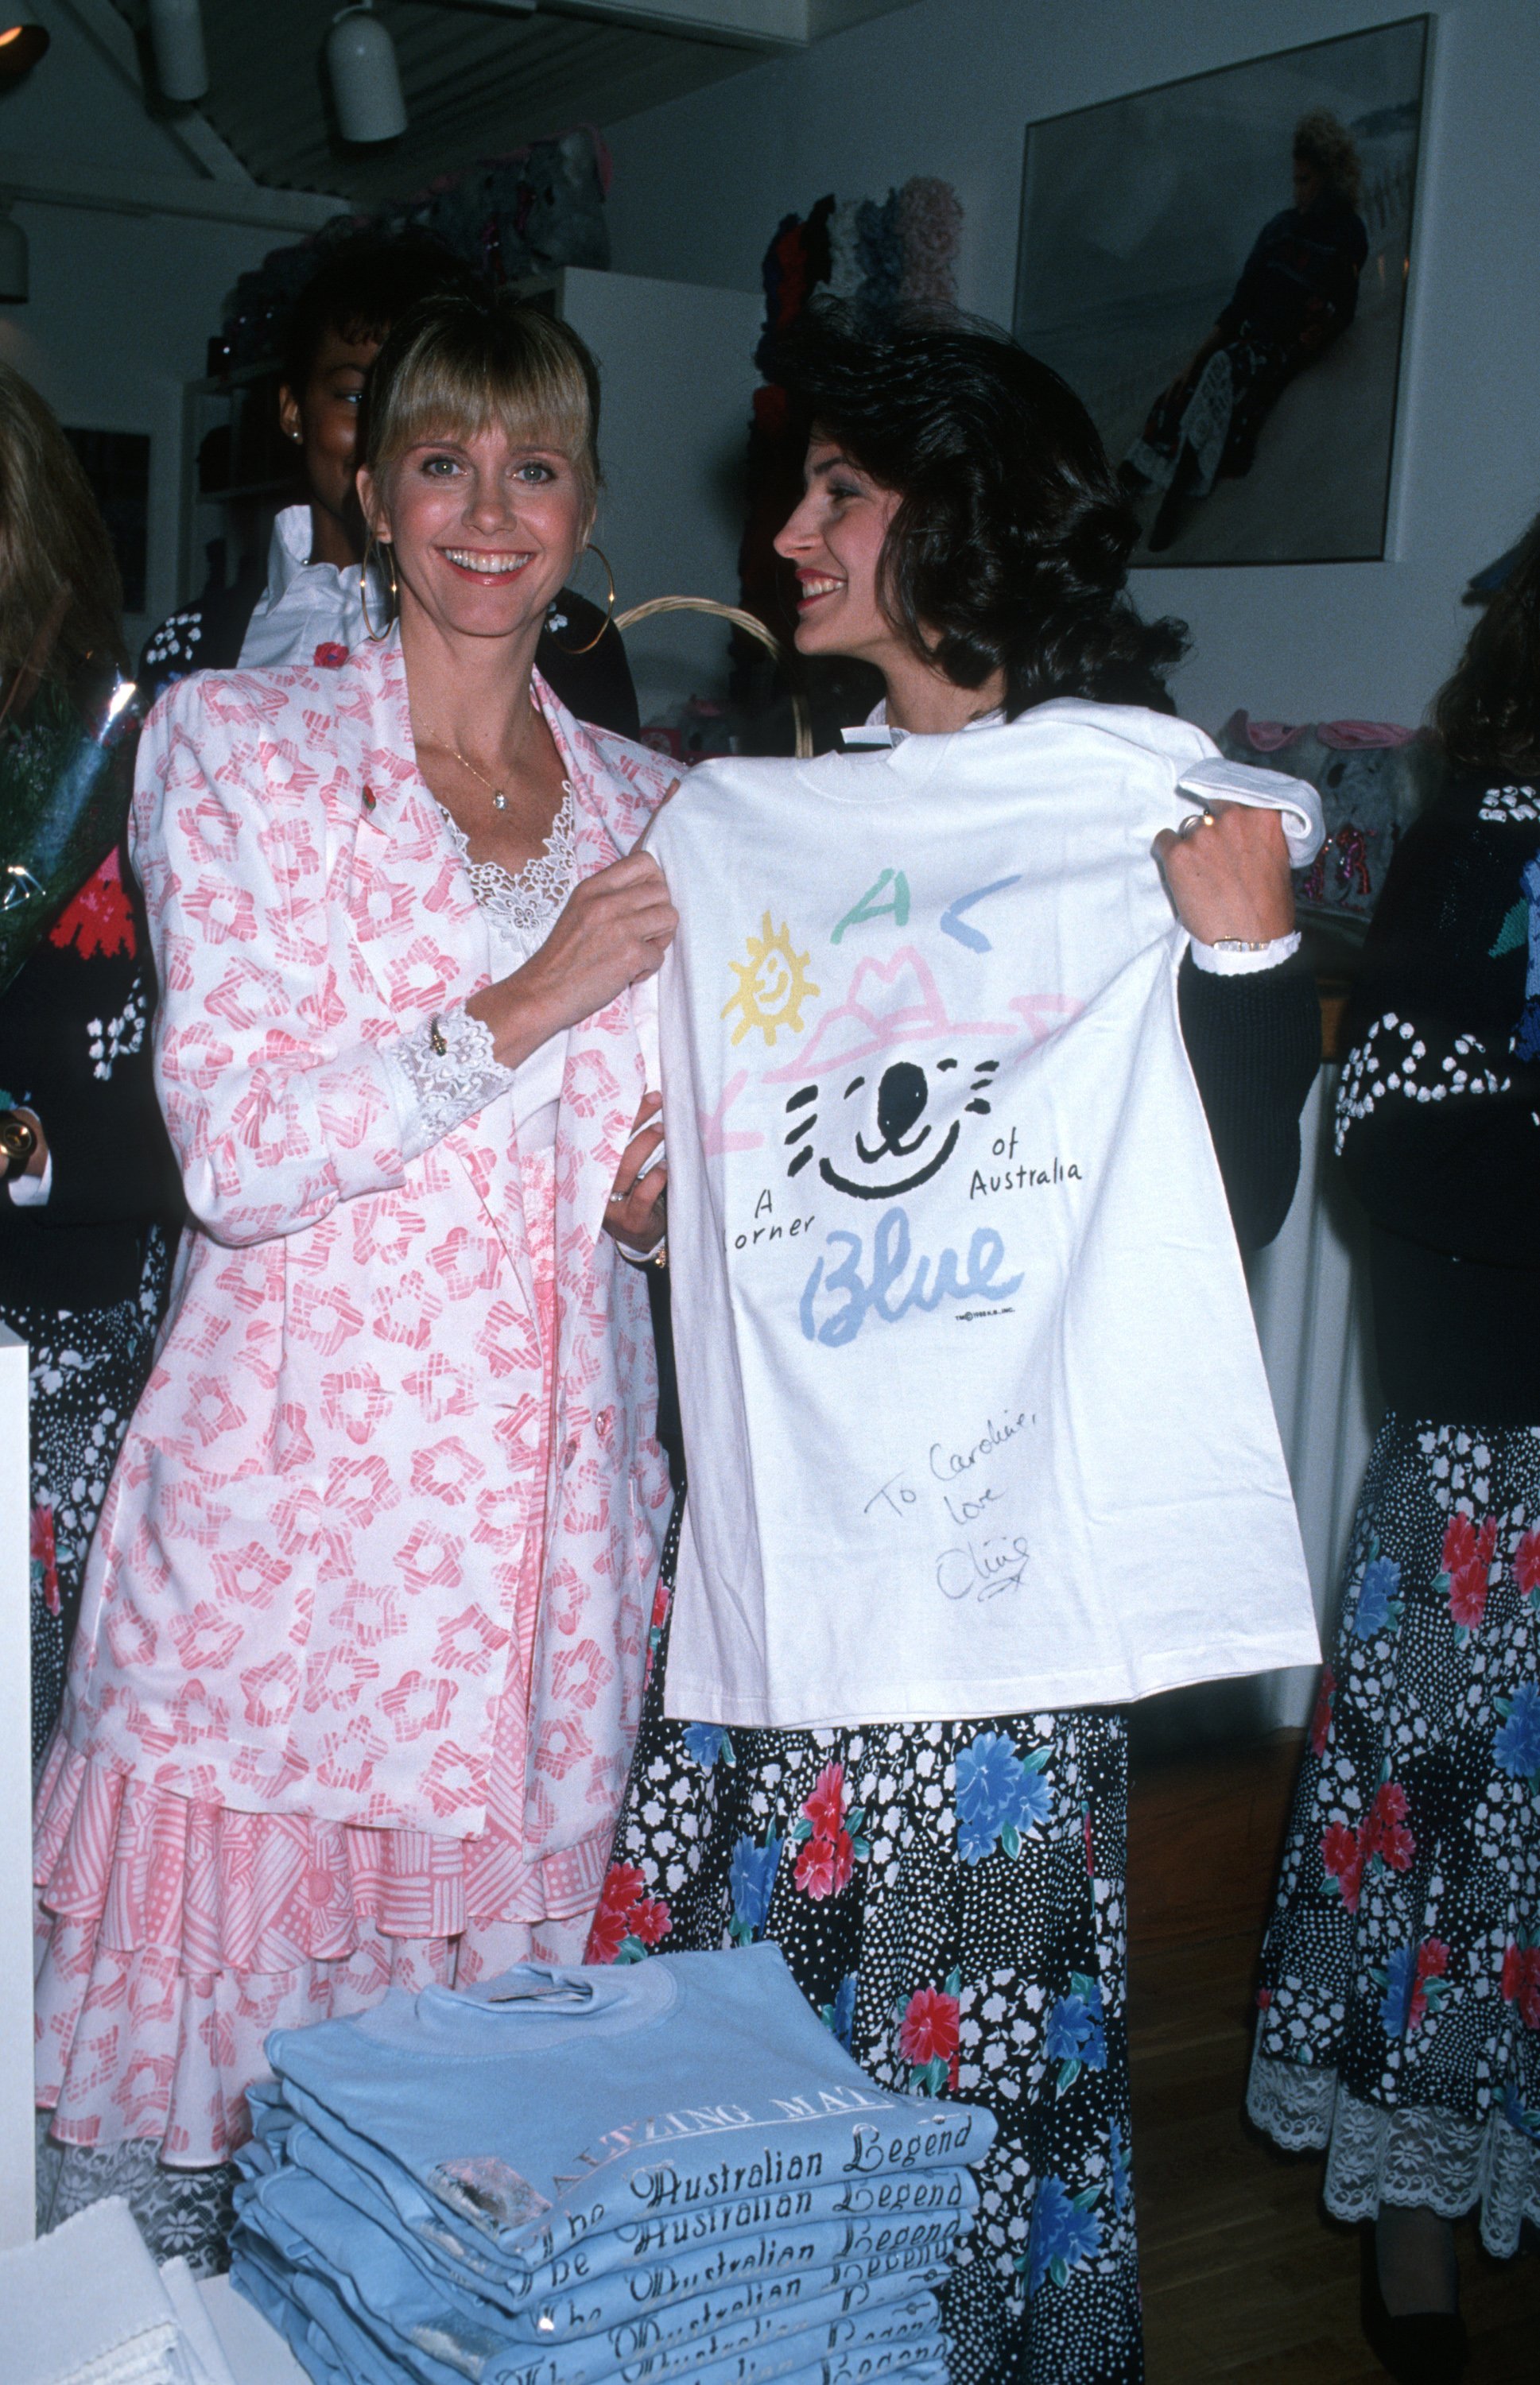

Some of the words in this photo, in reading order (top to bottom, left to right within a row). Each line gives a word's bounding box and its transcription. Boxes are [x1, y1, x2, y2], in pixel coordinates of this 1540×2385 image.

[992, 1127, 1018, 1159] of
[970, 1158, 1082, 1200] Australia
[754, 1189, 772, 1219] A
[724, 1216, 815, 1251] orner
[800, 1206, 1025, 1348] Blue
[863, 1470, 917, 1517] To
[626, 2146, 823, 2208] Australian
[843, 2112, 972, 2172] Legend
